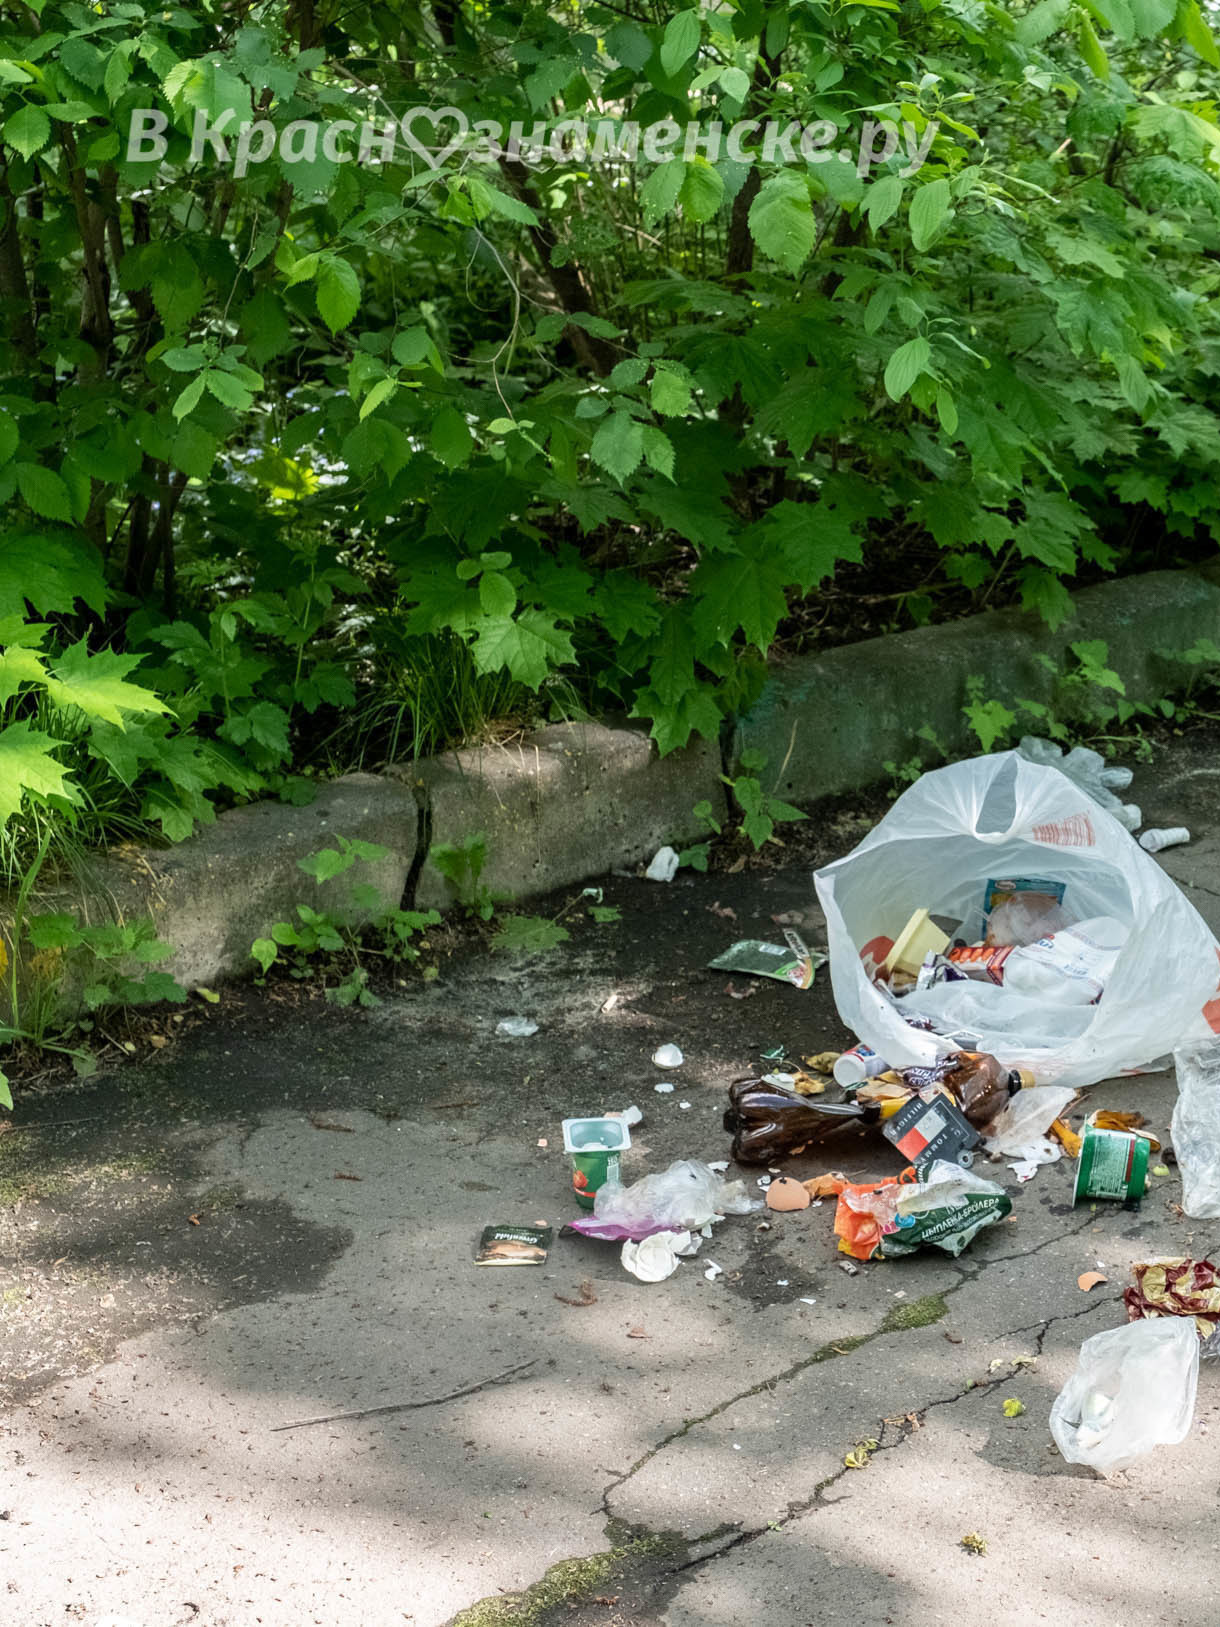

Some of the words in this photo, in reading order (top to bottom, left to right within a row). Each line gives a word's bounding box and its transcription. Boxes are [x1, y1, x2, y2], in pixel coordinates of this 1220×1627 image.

[888, 1101, 924, 1137] HILFIGER
[919, 1132, 948, 1162] TOMMY
[494, 1232, 538, 1244] Greenfield
